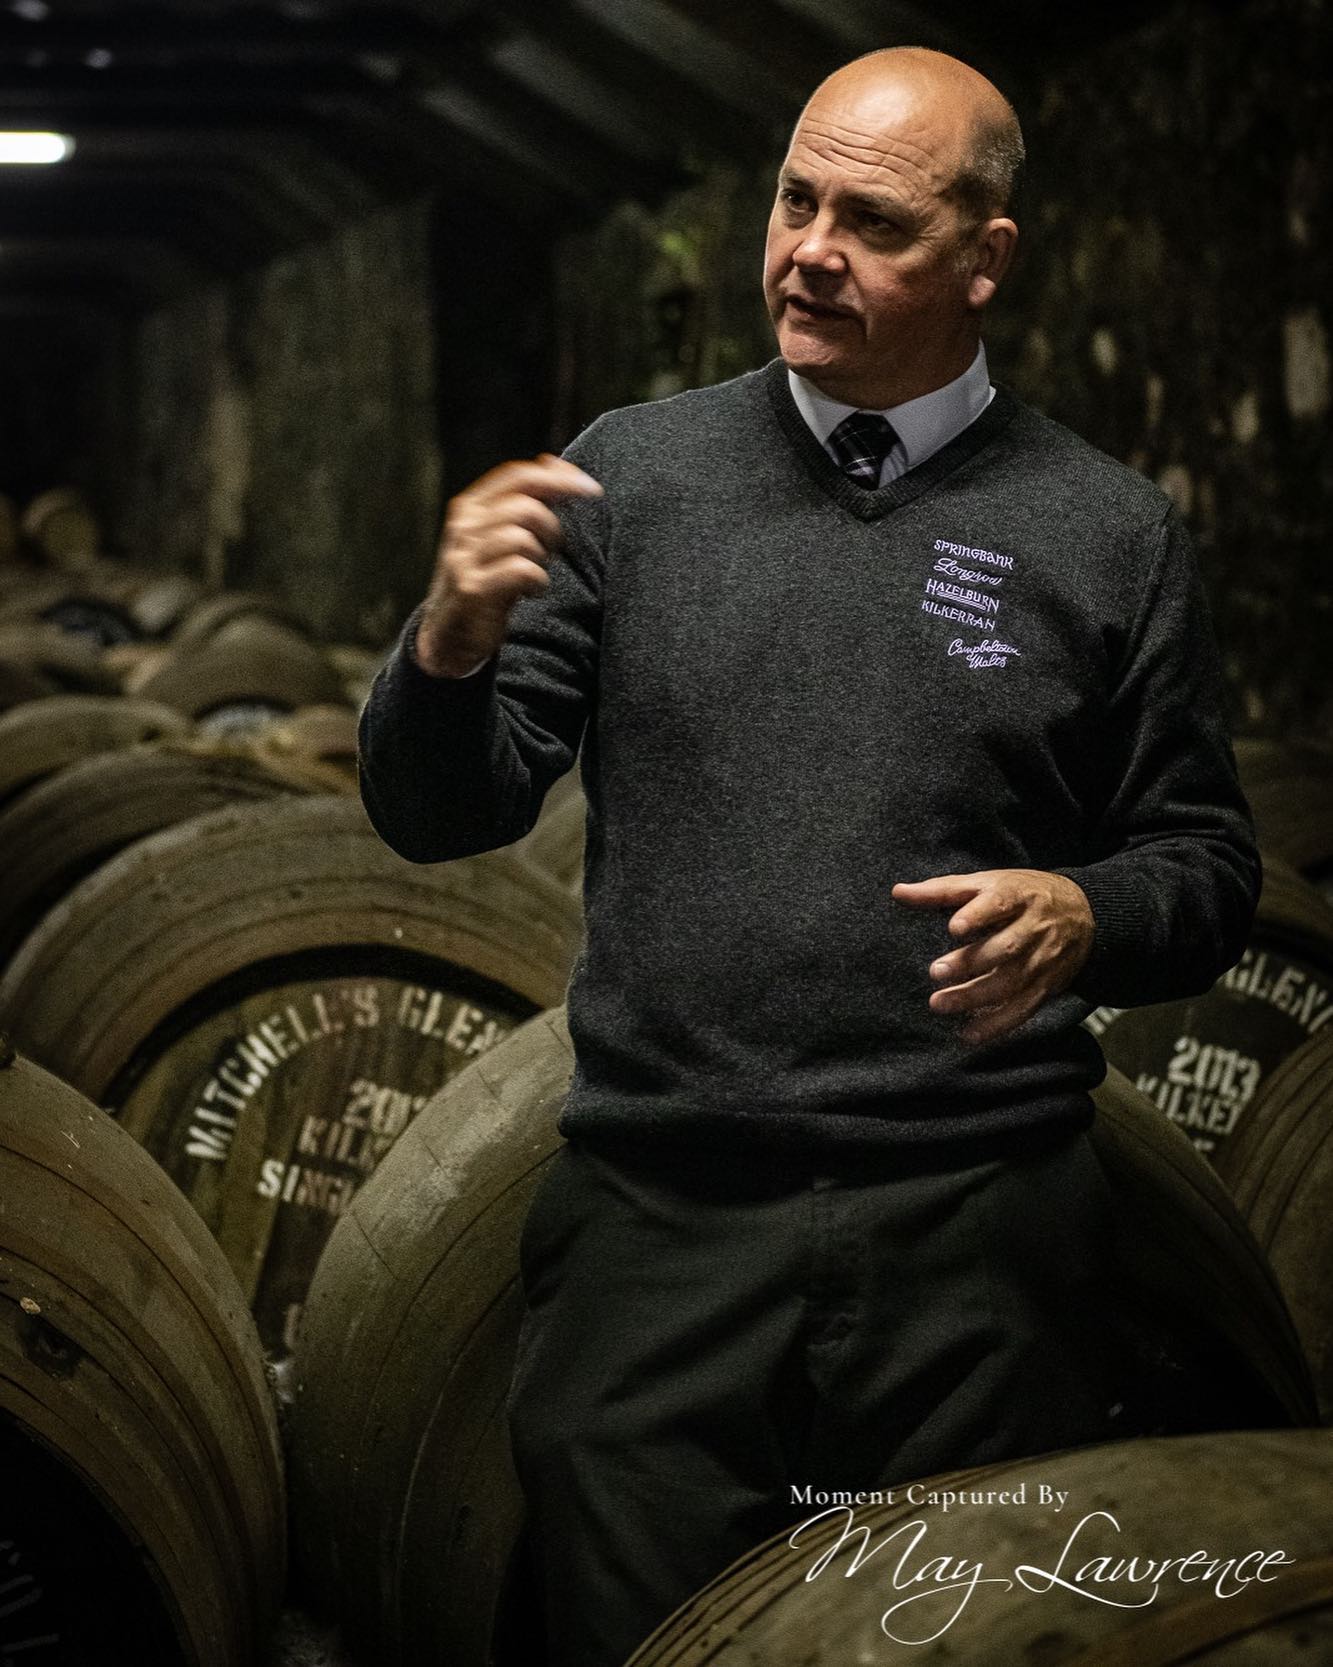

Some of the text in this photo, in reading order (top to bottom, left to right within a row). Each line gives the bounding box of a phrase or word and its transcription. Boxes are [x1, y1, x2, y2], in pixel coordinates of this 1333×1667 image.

[933, 539, 1014, 570] SPRINGBANK
[924, 578, 1000, 614] HAZELBURN
[921, 599, 996, 632] KILKERRAN
